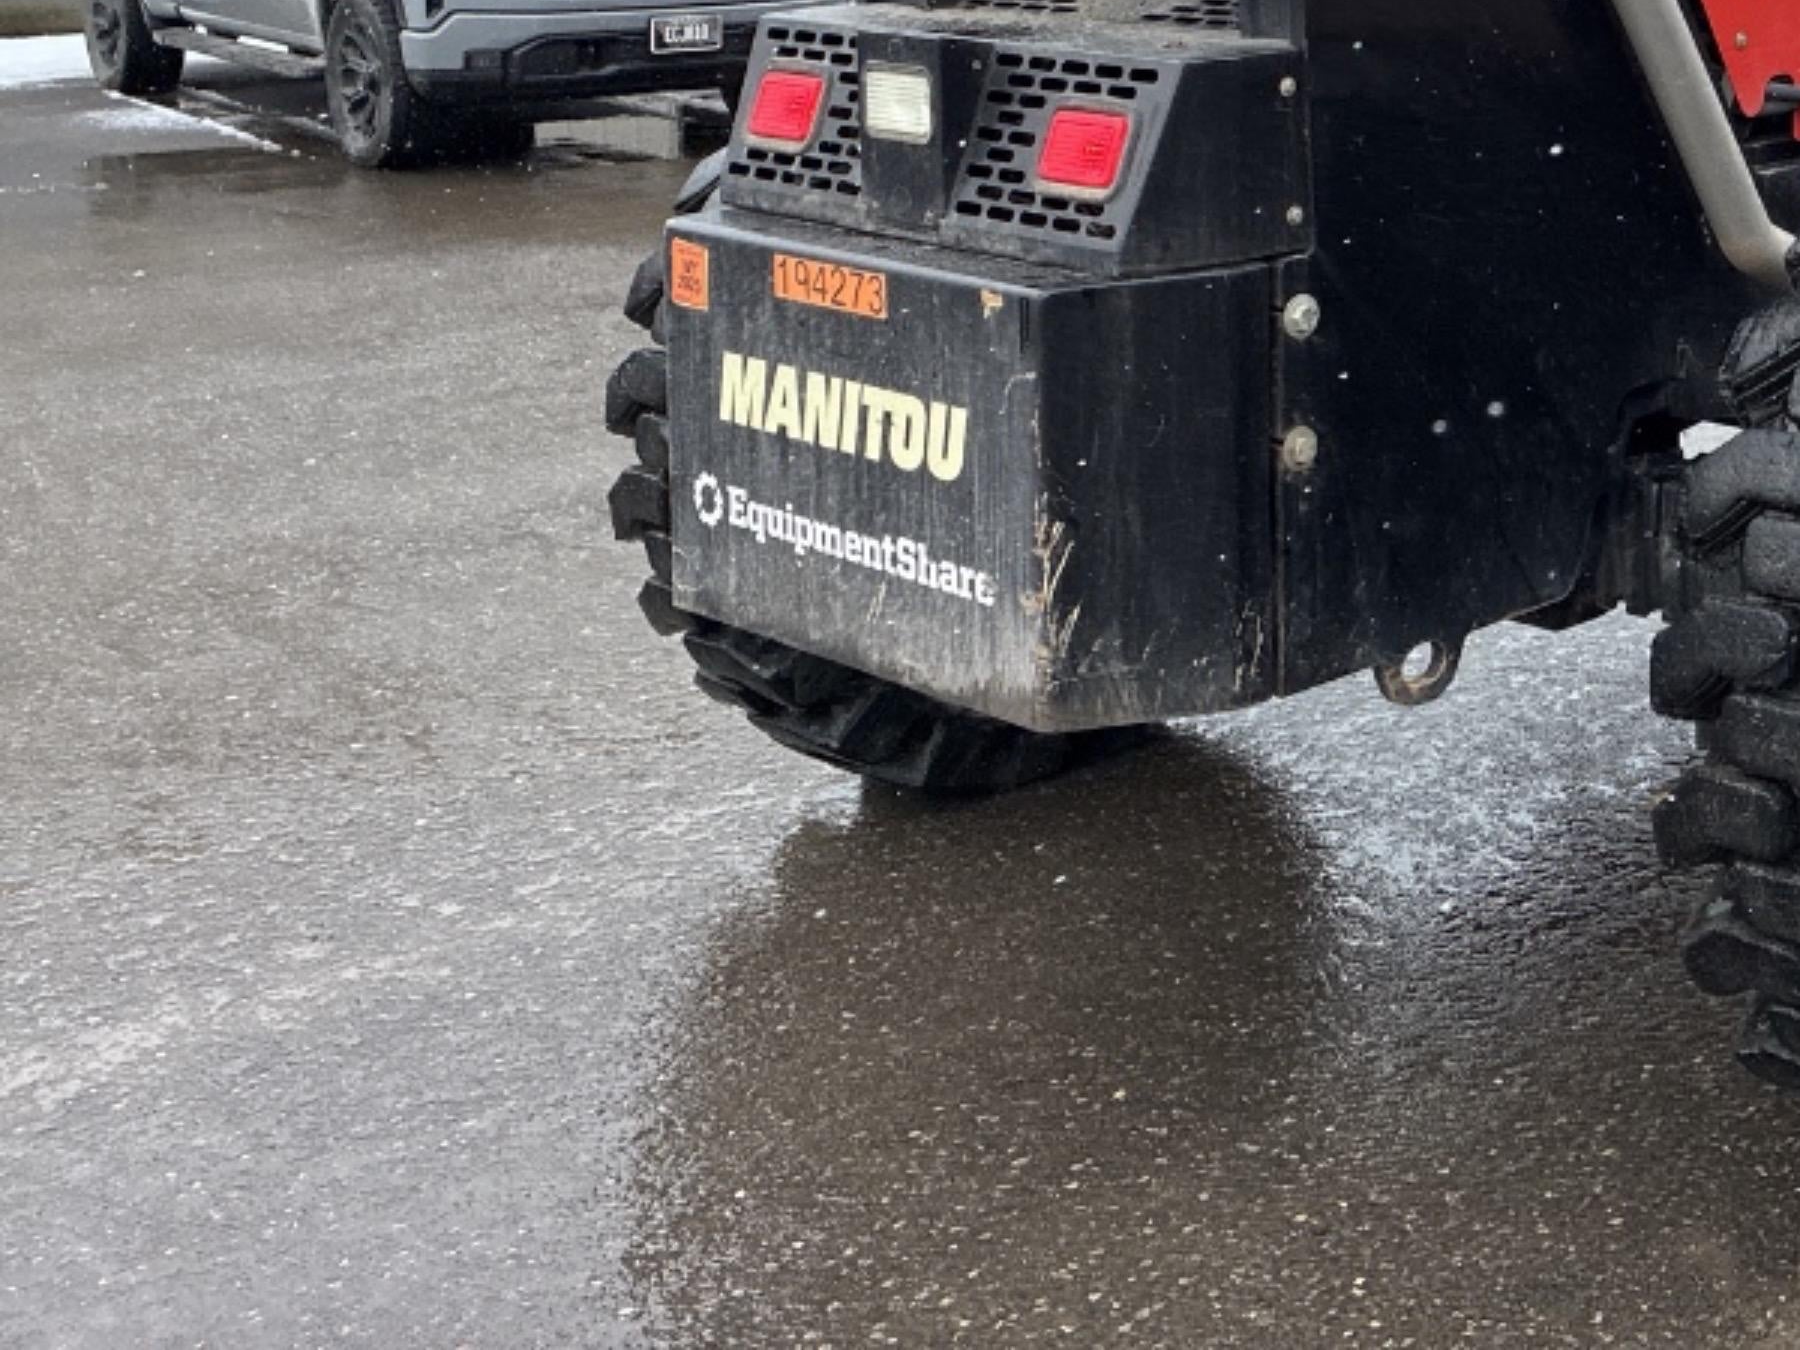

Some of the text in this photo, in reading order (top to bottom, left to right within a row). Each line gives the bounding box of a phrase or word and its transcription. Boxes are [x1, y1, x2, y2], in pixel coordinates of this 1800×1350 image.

[778, 257, 883, 315] 194273
[719, 350, 968, 482] MANITOU
[726, 484, 997, 607] EquipmentShare
